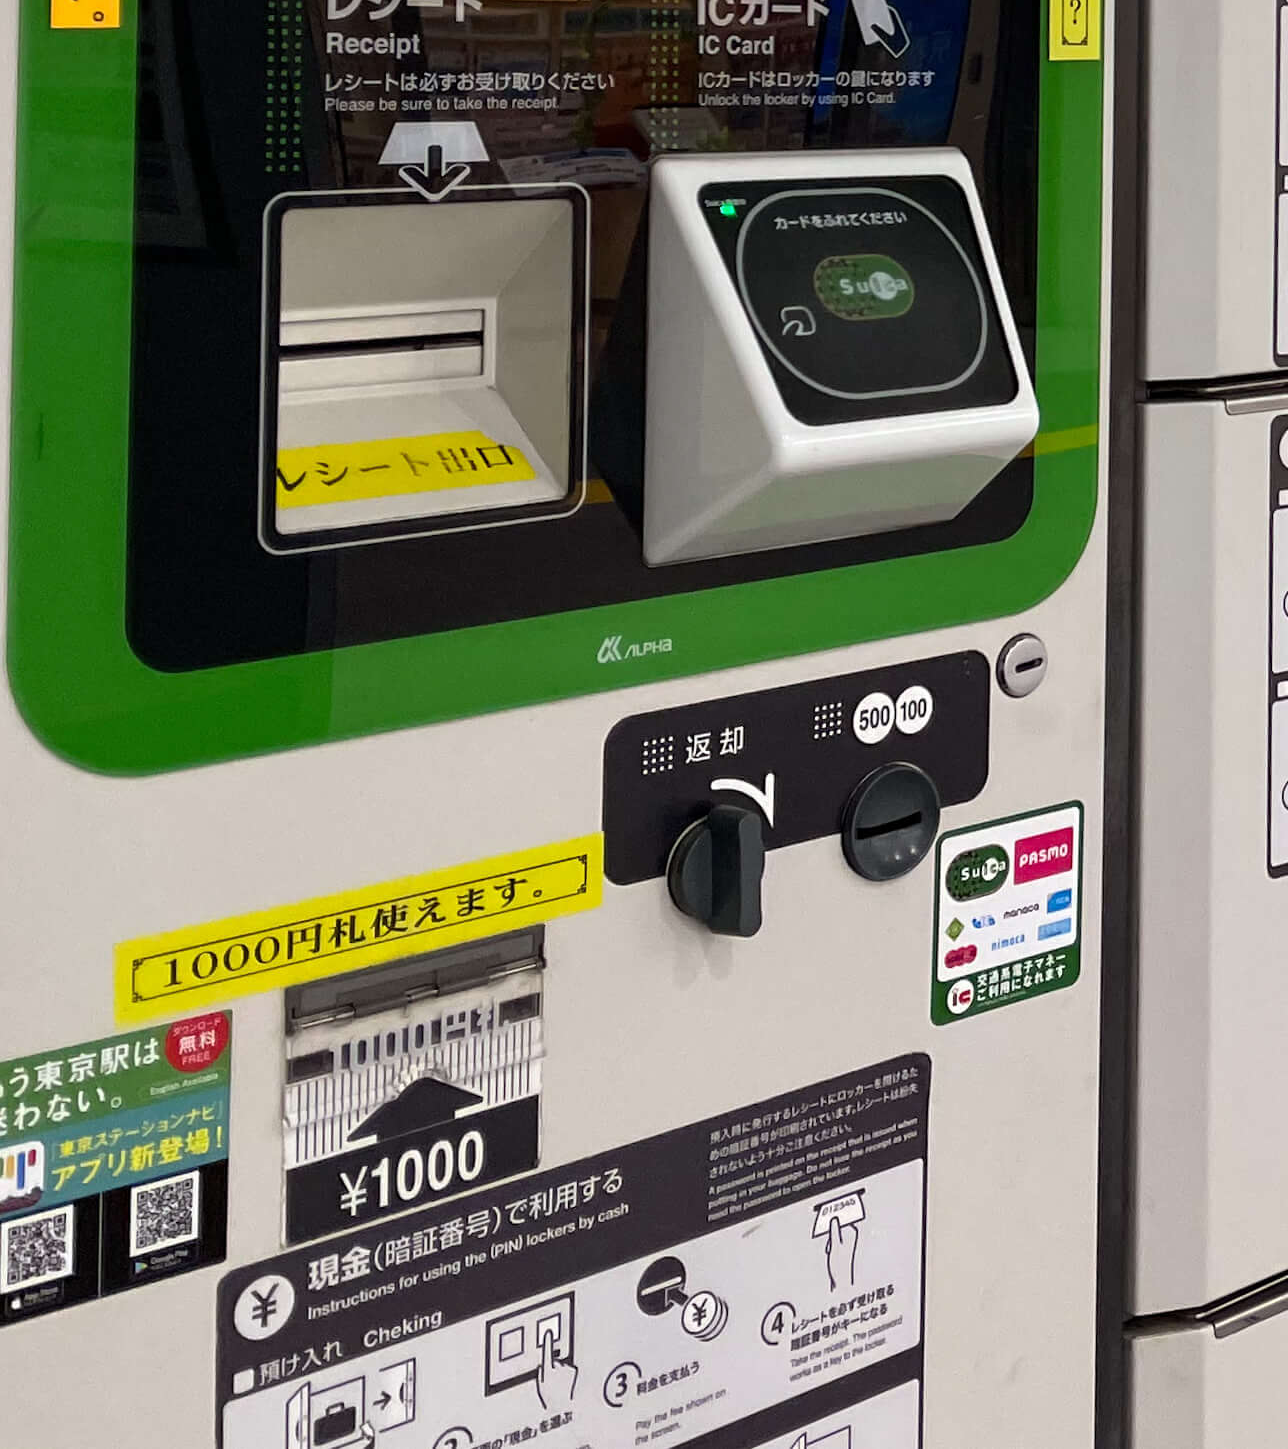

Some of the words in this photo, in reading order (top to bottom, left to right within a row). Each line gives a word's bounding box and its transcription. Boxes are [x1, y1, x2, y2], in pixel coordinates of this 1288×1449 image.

[326, 32, 420, 59] Receipt
[698, 36, 720, 54] IC
[726, 36, 775, 55] Card
[324, 72, 616, 93] レシートは必ずお受け取りください
[698, 70, 936, 88] ICカードはロッカーの鍵になります
[324, 97, 376, 111] Please
[378, 97, 397, 111] be
[401, 100, 432, 111] sure
[436, 98, 449, 111] to
[453, 97, 482, 111] take
[486, 97, 508, 110] the
[698, 93, 739, 106] Unlock
[742, 93, 761, 106] the
[764, 93, 799, 105] locker
[801, 93, 816, 108] by
[818, 93, 849, 107] using
[851, 92, 864, 104] IC
[775, 211, 907, 230] カードをふれてください
[839, 272, 908, 300] Suica
[859, 703, 890, 732] 500
[899, 696, 927, 723] 100
[686, 726, 745, 764] 返却
[961, 858, 1006, 881] Suica
[1019, 844, 1068, 867] PASMO
[1003, 904, 1039, 919] manaca
[163, 874, 544, 989] 1000円札使えます。
[976, 954, 1066, 987] 交通系電子マネー
[977, 965, 1066, 1001] ご利用になれます
[178, 1029, 216, 1055] 無料
[0, 1037, 160, 1099] う東京駅は
[182, 1053, 211, 1065] FREE
[338, 1129, 485, 1217] ¥1000
[307, 1283, 396, 1320] Instructions
[399, 1273, 420, 1291] for
[422, 1260, 461, 1284] using
[465, 1252, 487, 1269] the
[489, 1236, 524, 1263] (PIN)
[526, 1221, 576, 1249] lockers
[579, 1212, 596, 1232] by
[598, 1202, 629, 1223] cash
[259, 1341, 343, 1387] 預け入れ
[363, 1310, 443, 1350] Cheking
